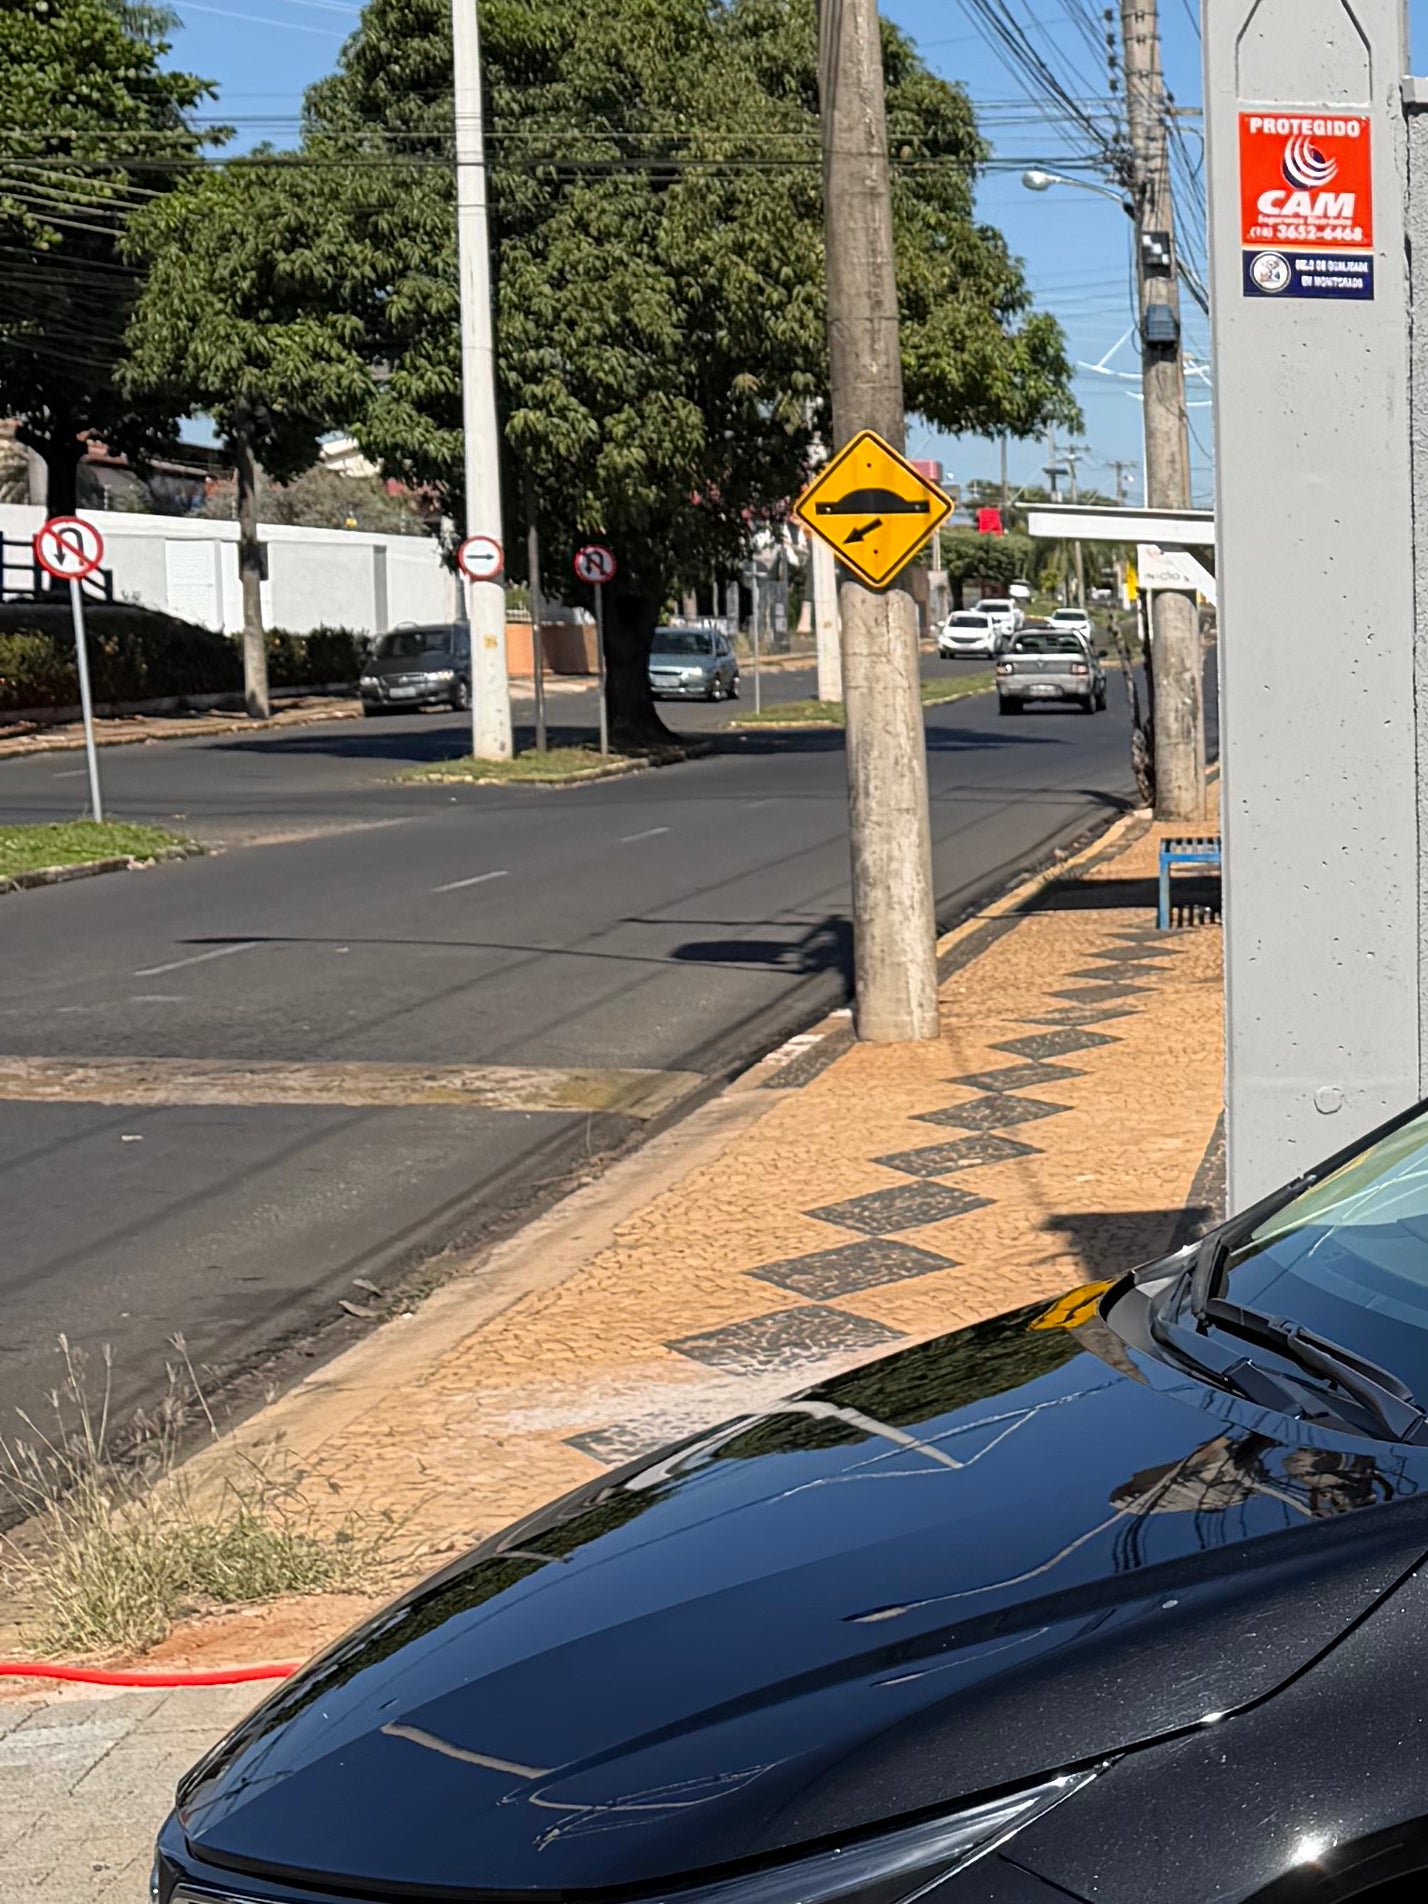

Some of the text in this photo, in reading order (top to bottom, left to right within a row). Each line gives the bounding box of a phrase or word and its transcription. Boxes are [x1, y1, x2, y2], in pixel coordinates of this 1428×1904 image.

[1248, 117, 1361, 137] PROTEGIDO
[1257, 189, 1356, 218] CAM
[1277, 225, 1363, 241] 3652-6468
